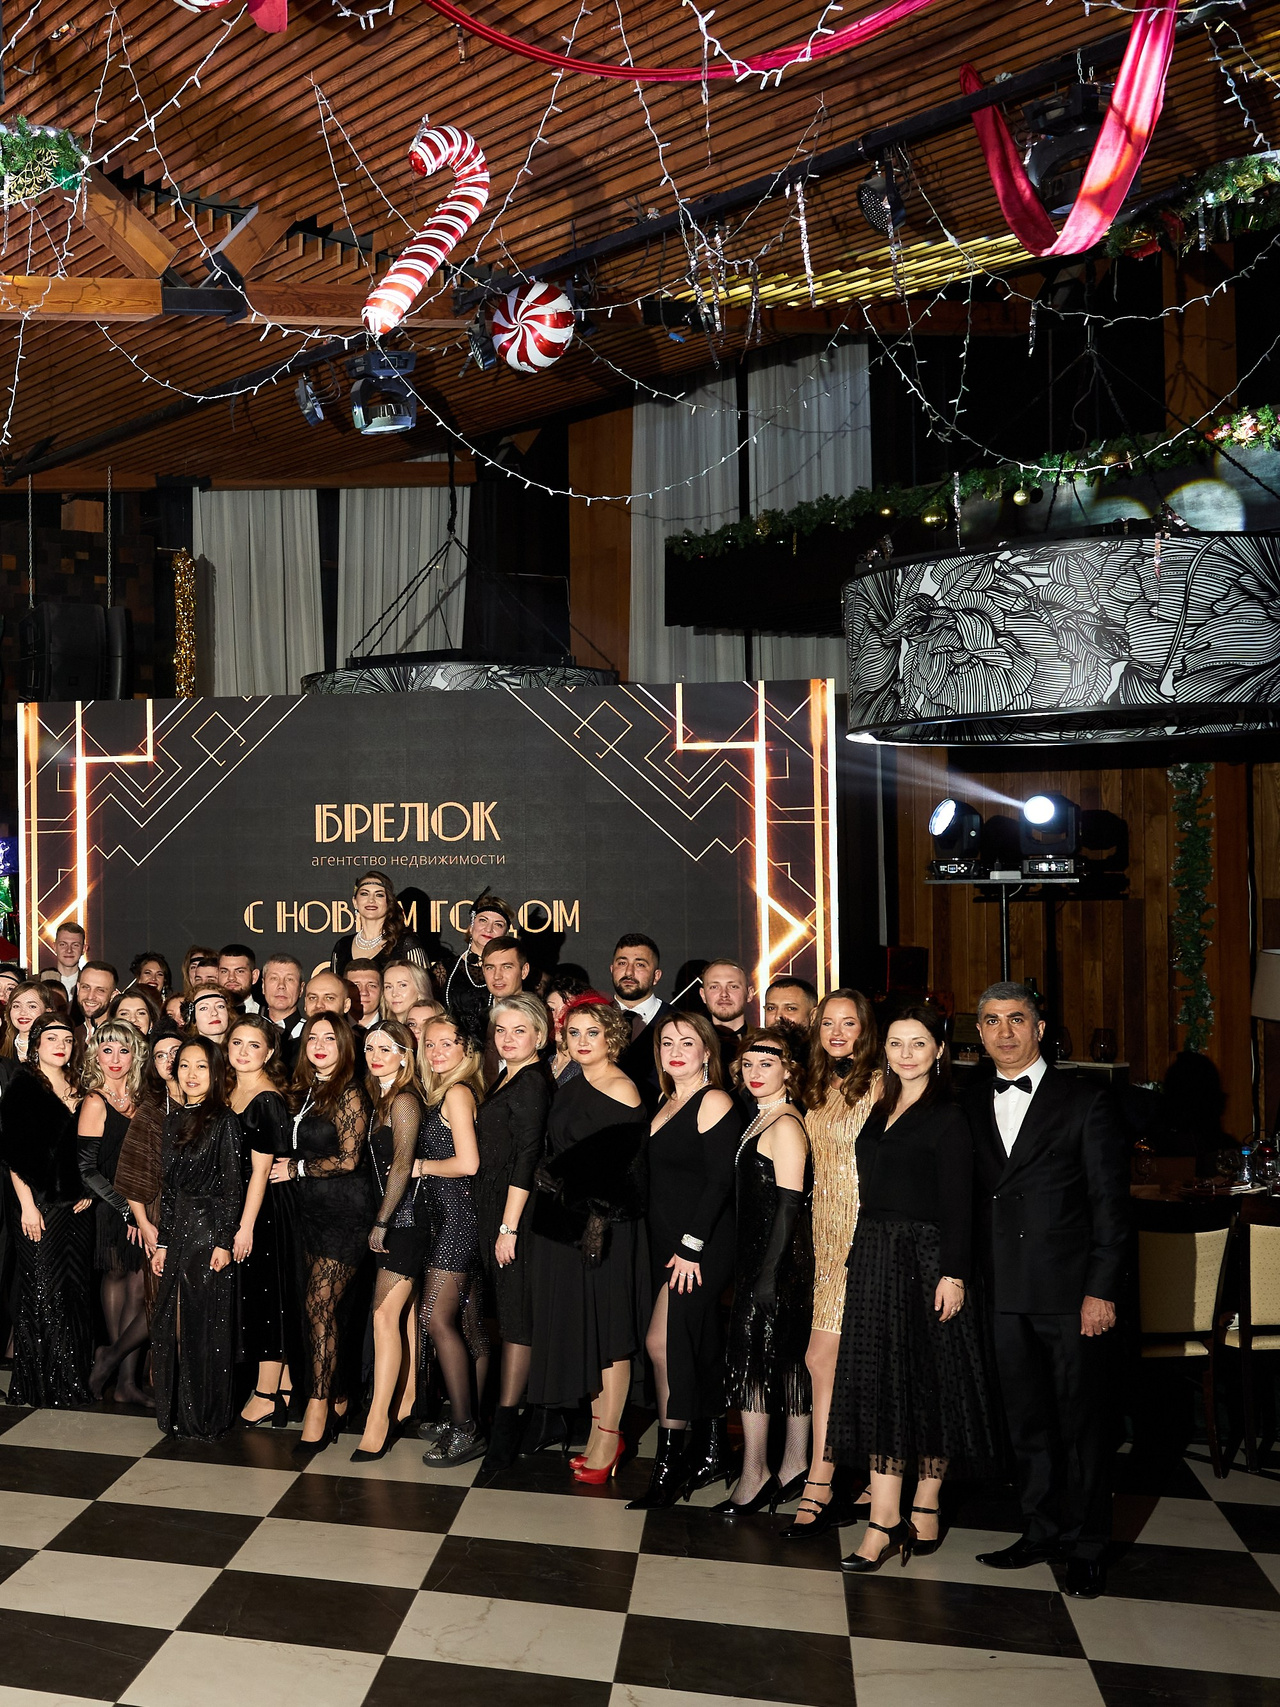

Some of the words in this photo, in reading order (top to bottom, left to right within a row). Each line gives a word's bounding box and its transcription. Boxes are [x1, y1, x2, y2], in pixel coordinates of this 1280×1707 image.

[314, 801, 502, 843] БРЕЛОК
[311, 855, 387, 867] агентство
[390, 854, 506, 868] недвижимости
[243, 900, 264, 934] С
[276, 900, 418, 934] НОВМ
[430, 899, 580, 938] ГООМ
